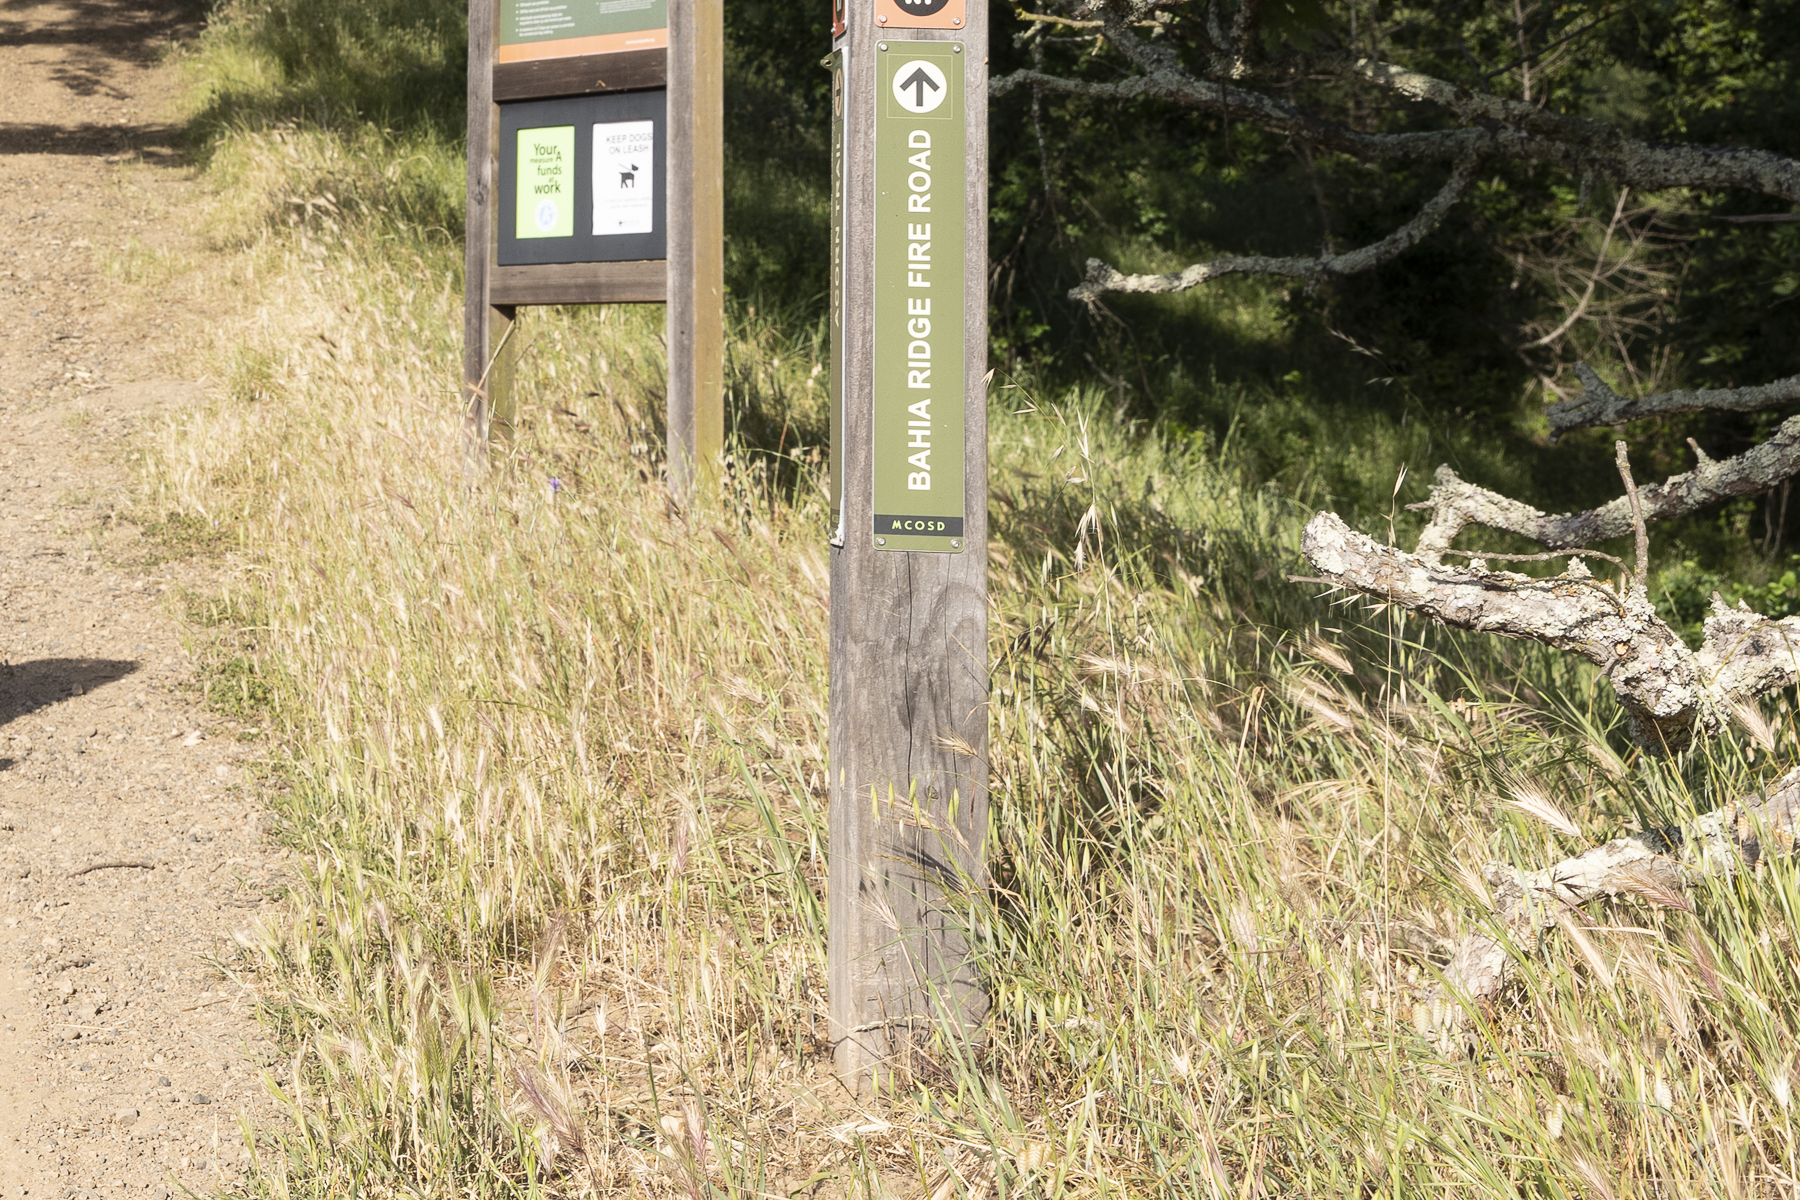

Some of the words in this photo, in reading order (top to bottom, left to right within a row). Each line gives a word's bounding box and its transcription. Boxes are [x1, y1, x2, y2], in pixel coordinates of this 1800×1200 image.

[606, 134, 627, 143] KEEP
[629, 132, 653, 143] DOGS
[534, 143, 558, 156] Your
[609, 146, 620, 155] ON
[623, 144, 649, 154] LEASH
[555, 151, 562, 162] A
[537, 164, 562, 176] funds
[908, 129, 932, 213] ROAD
[534, 180, 562, 194] work
[908, 222, 931, 288] FIRE
[908, 297, 931, 389] RIDGE
[908, 398, 931, 491] BAHIA
[892, 520, 946, 531] MCOSD
